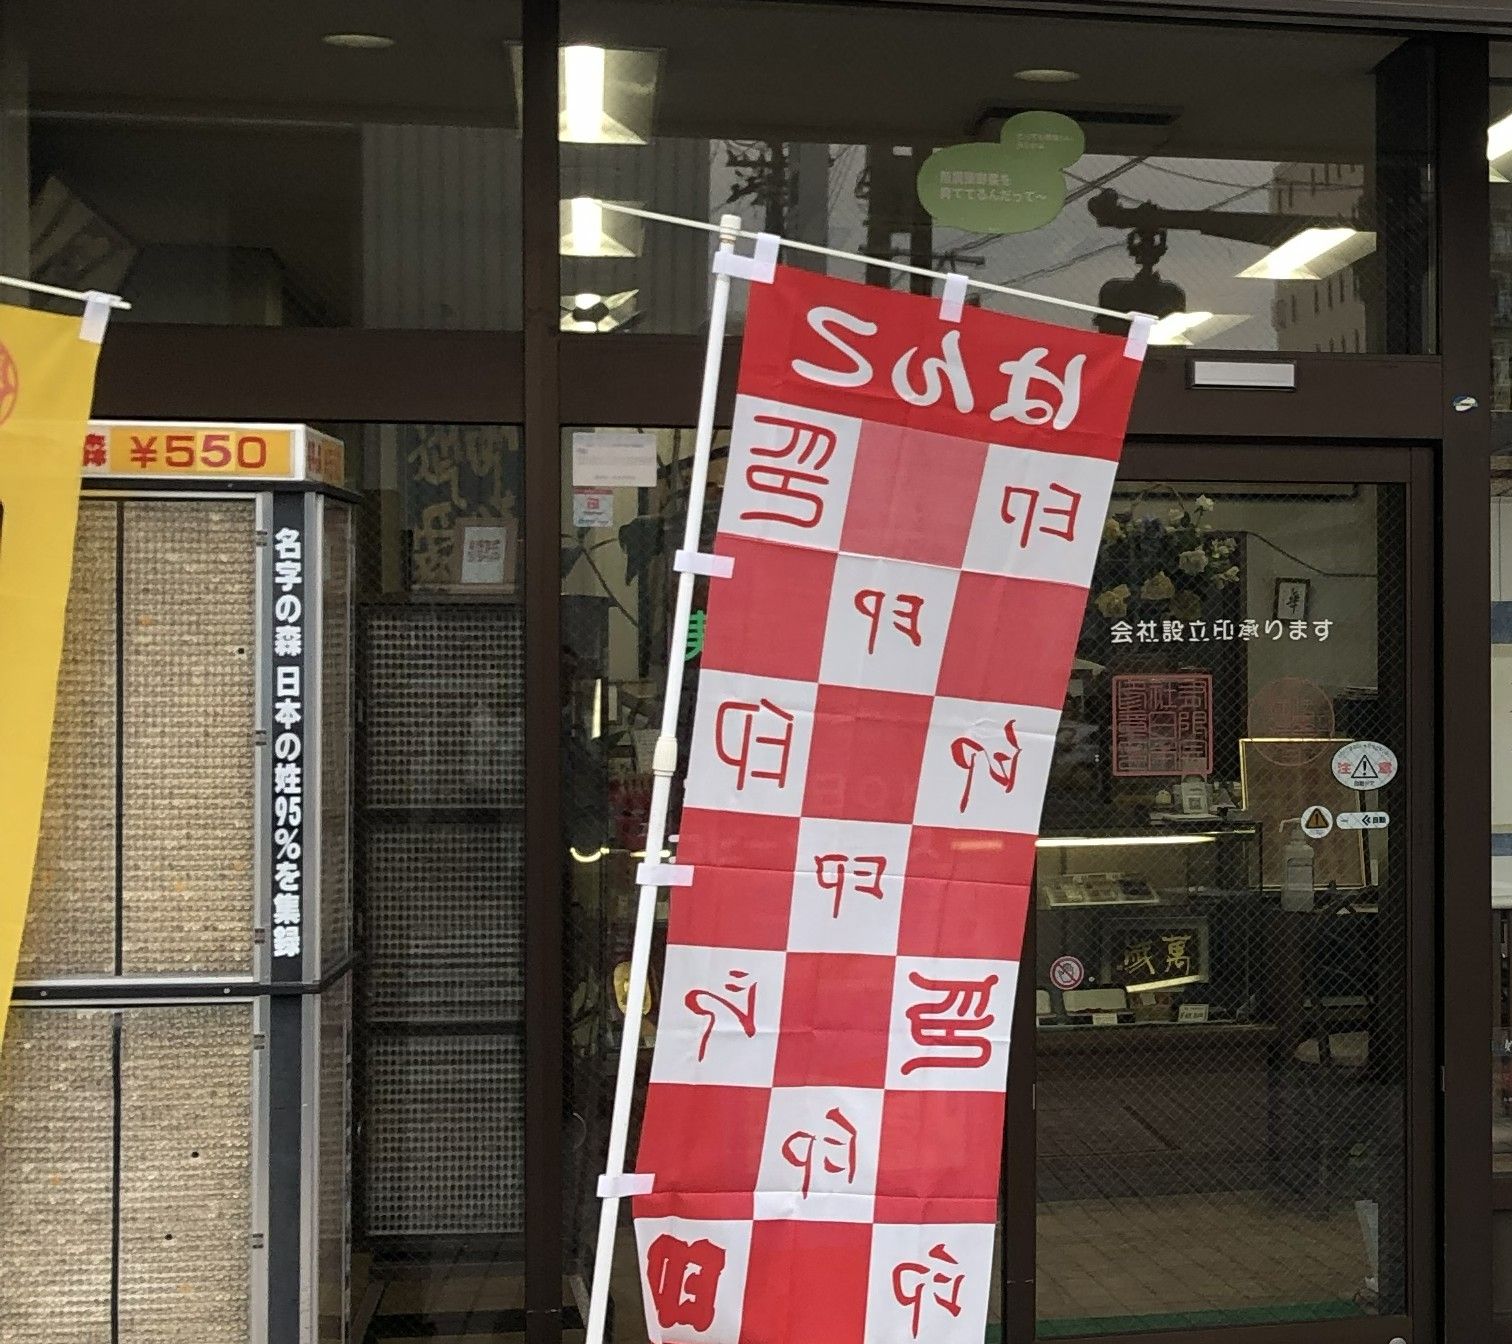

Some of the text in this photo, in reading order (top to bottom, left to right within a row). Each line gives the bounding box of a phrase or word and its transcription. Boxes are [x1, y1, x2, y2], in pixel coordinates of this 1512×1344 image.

[130, 435, 268, 469] ¥550
[274, 527, 303, 657] 名字の森
[1110, 618, 1334, 644] 会社設立印承ります
